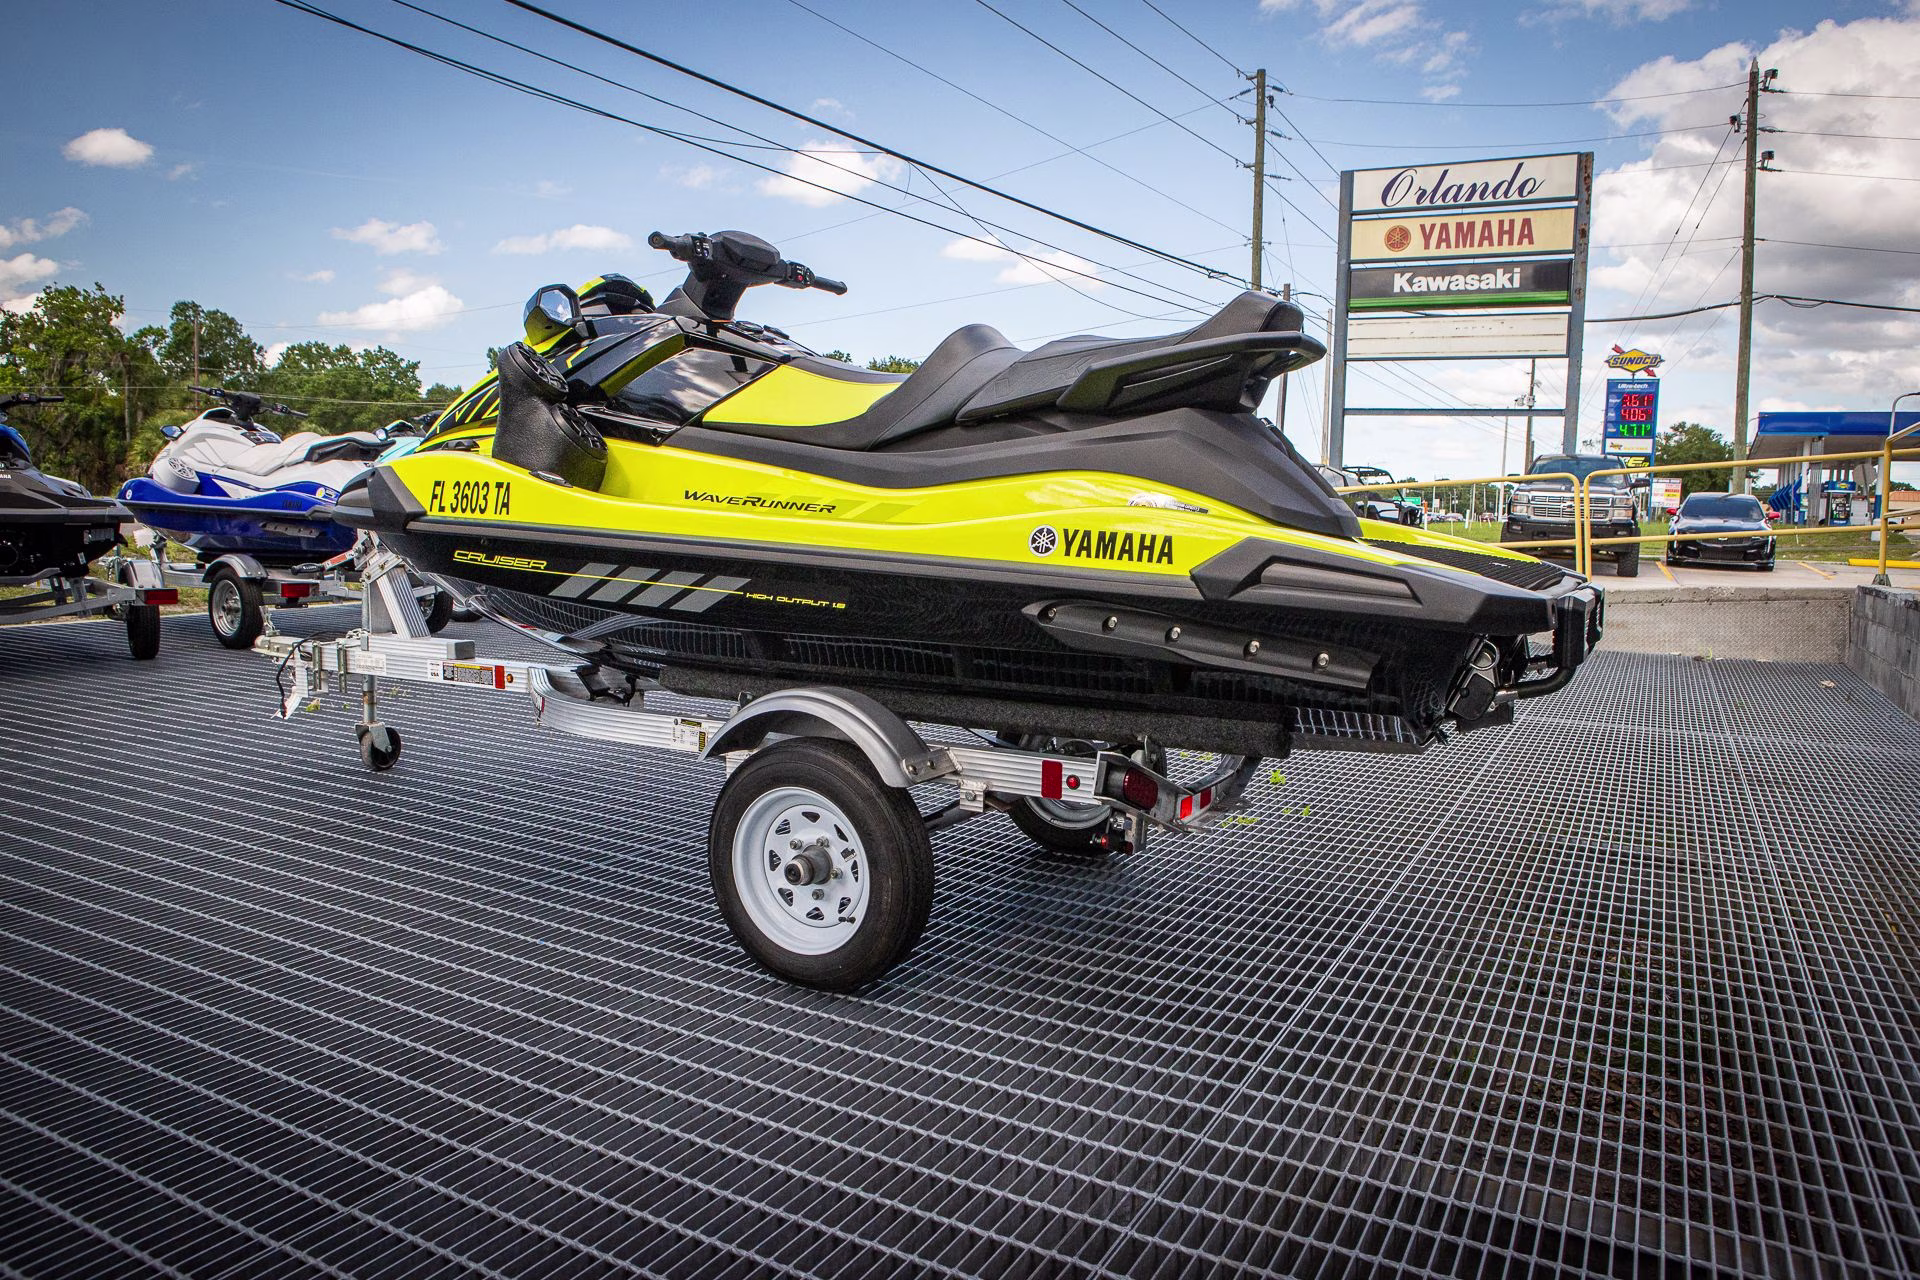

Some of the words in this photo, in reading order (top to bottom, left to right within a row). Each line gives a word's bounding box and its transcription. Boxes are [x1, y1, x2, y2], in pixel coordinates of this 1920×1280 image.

[1380, 161, 1546, 209] Orlando
[1419, 217, 1535, 250] YAMAHA
[1393, 267, 1521, 293] Kawasaki
[1611, 356, 1659, 366] SUNOCO
[429, 480, 446, 513] FL
[450, 480, 490, 515] 3603
[494, 481, 511, 516] TA
[453, 549, 548, 570] CRUISER
[1062, 527, 1174, 565] YAMAHA
[746, 592, 774, 601] HIGH
[776, 596, 830, 607] OUTPUT
